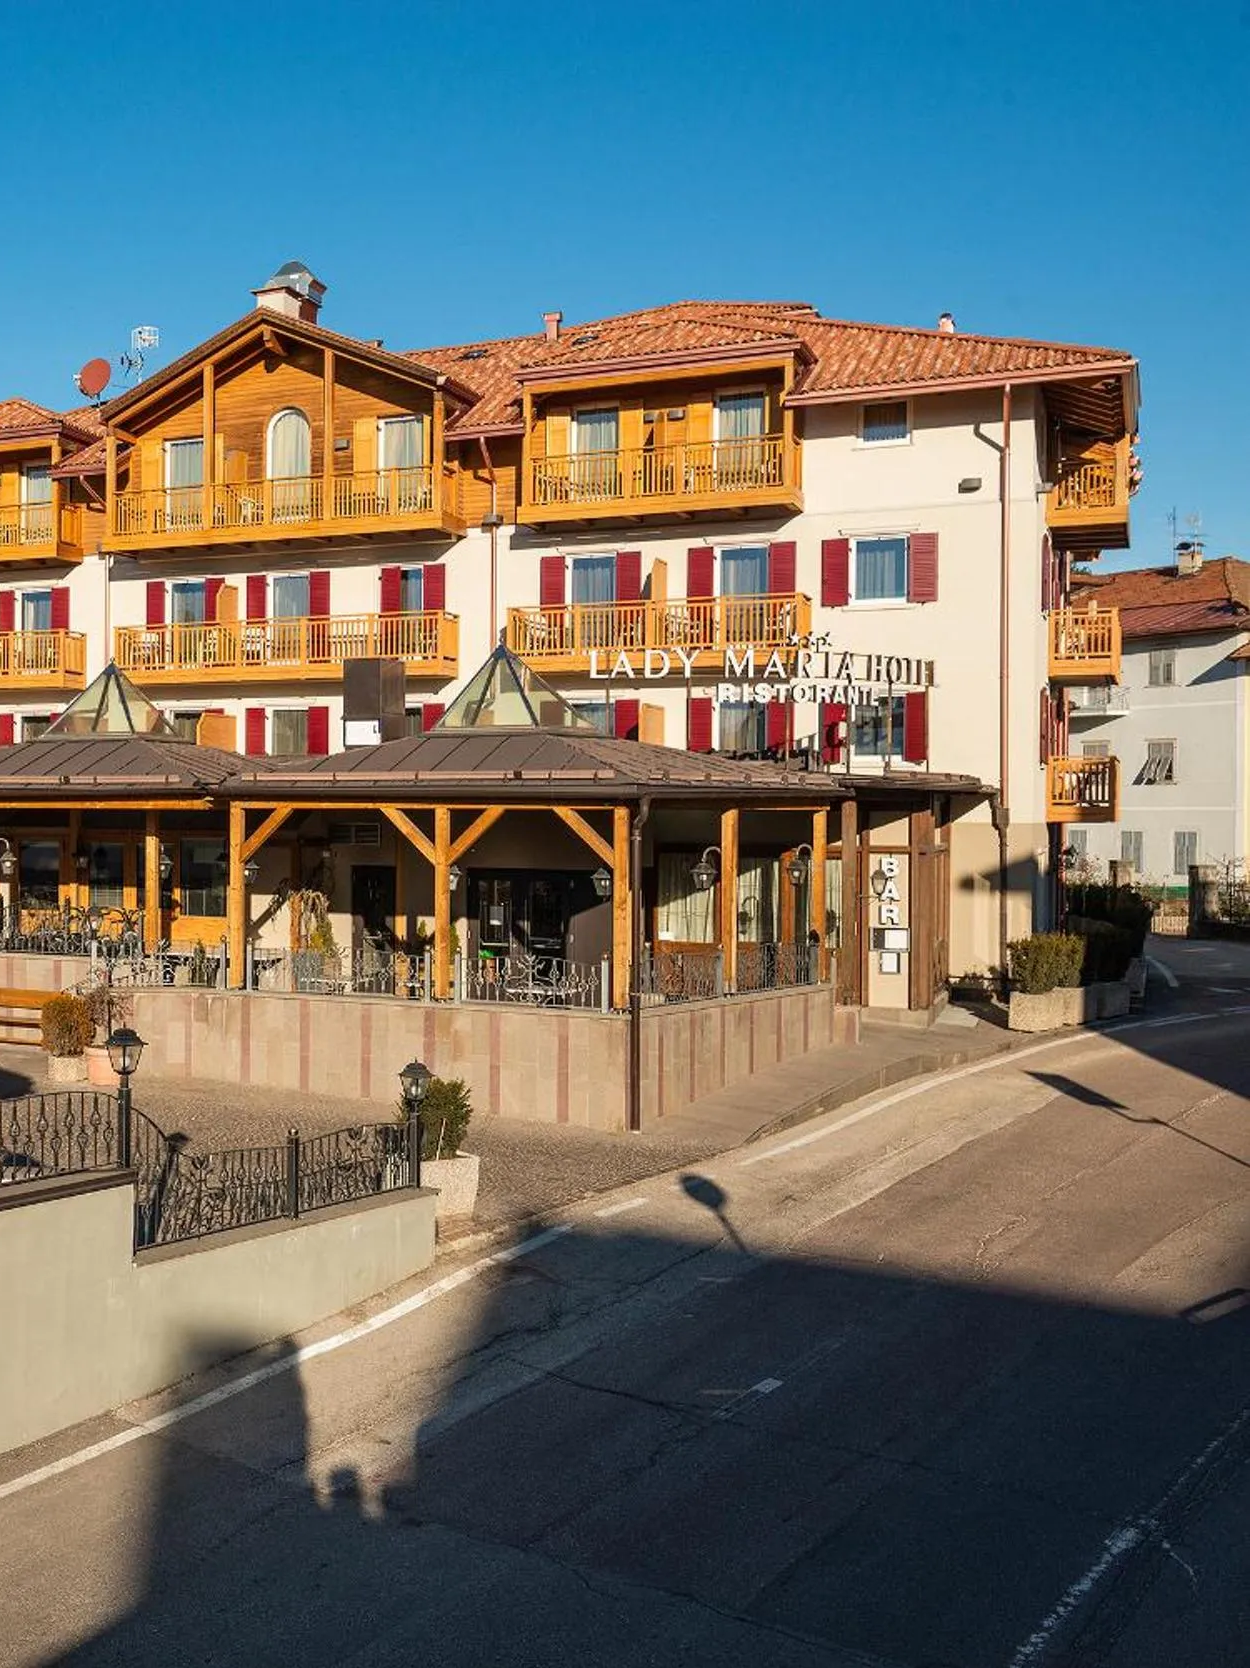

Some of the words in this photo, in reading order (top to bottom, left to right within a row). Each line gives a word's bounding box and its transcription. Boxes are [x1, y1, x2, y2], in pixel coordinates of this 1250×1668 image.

[589, 649, 700, 680] LADY
[723, 648, 855, 681] MARIA
[880, 857, 900, 926] BAR
